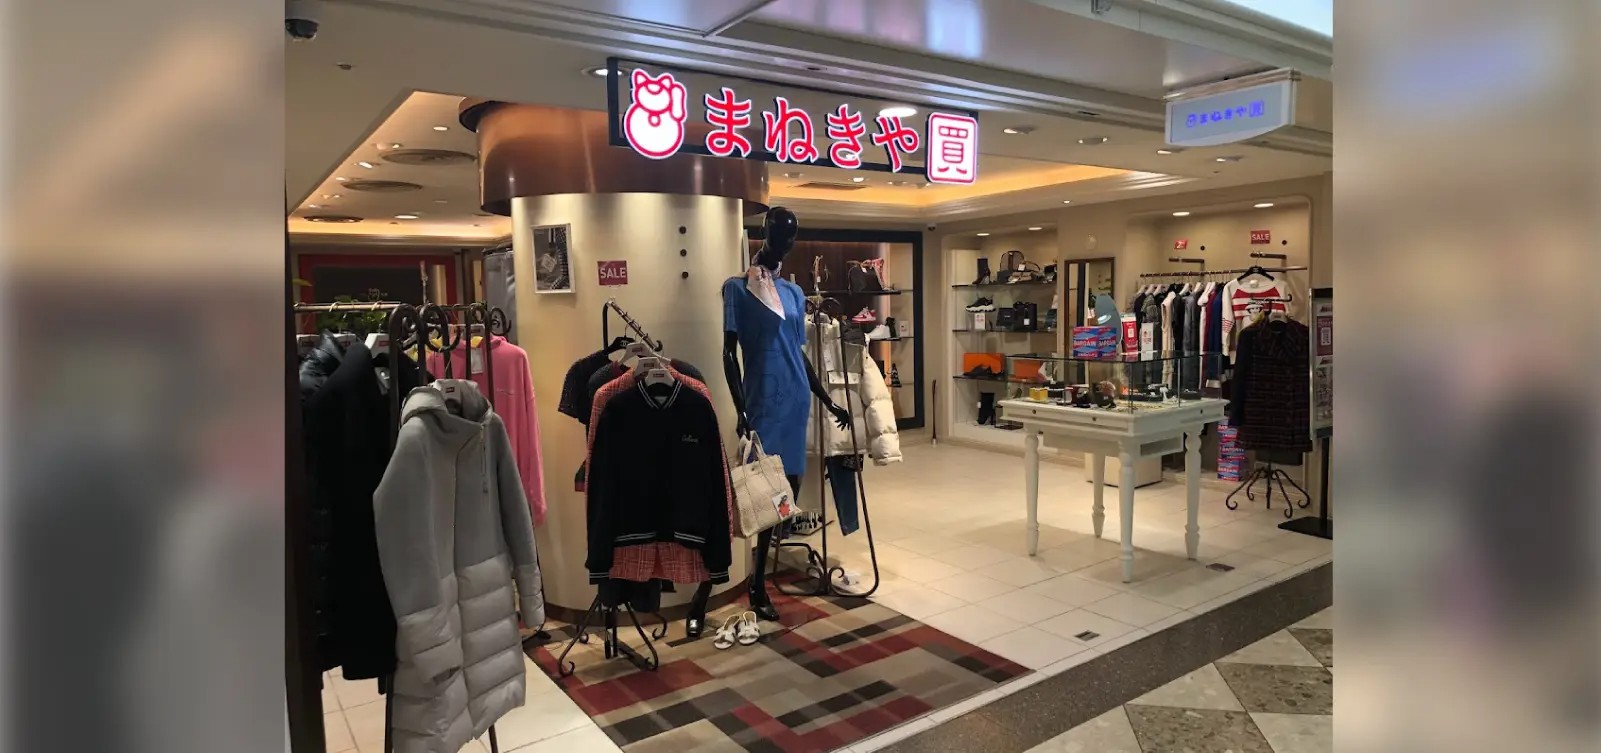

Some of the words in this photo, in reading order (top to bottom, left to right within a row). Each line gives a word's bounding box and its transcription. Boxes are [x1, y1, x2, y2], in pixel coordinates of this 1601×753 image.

[704, 87, 920, 173] まねきや
[1252, 233, 1270, 241] SALE
[600, 267, 626, 279] SALE
